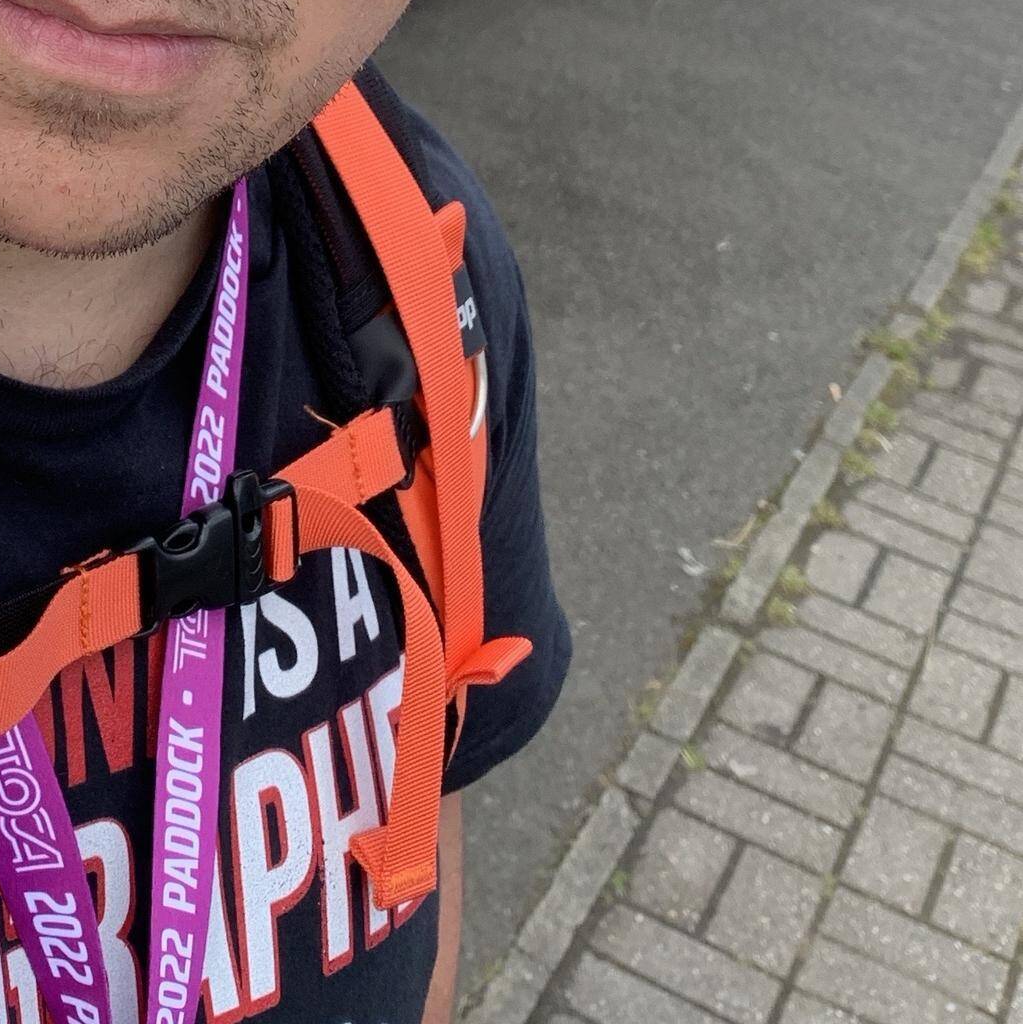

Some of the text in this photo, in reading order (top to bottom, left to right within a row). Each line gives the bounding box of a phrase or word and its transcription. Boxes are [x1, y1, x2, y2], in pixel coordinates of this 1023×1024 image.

[191, 219, 244, 506] 2022 PADDOCK
[240, 546, 380, 720] IS A
[162, 717, 204, 915] PADDOCK
[23, 891, 94, 987] 2022
